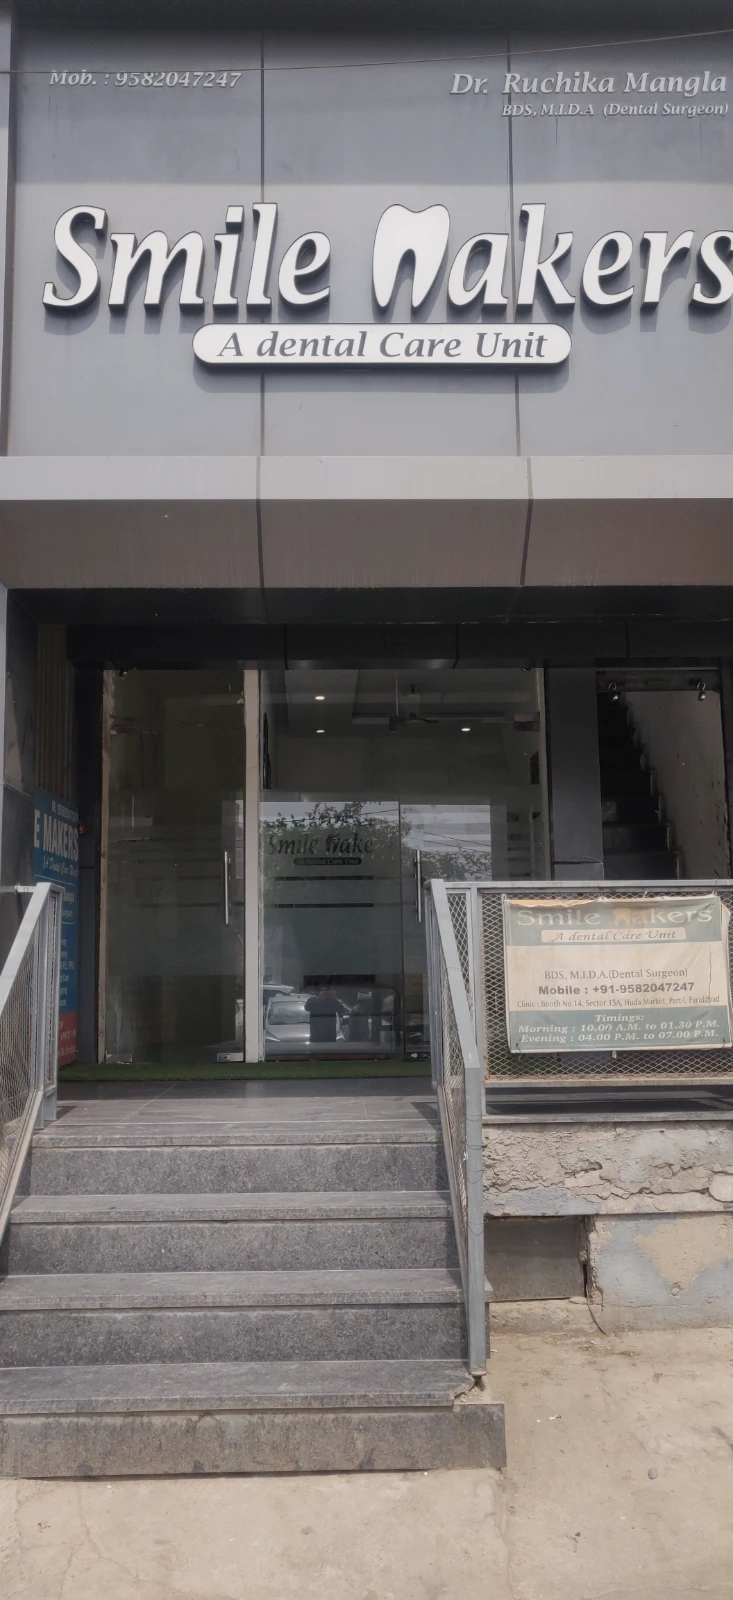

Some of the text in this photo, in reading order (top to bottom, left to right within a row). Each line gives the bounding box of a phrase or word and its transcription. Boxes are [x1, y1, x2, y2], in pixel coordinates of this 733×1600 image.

[49, 70, 97, 86] Mob.
[115, 71, 242, 88] 9582047247
[449, 71, 728, 98] Dr. Ruchika Mangla
[502, 103, 729, 118] BDS, M.I.D.A (Dental Surgeon)
[42, 203, 332, 311] Smile
[216, 331, 548, 358] A dental Care Unit
[43, 812, 79, 862] MAKERS
[516, 908, 600, 926] Smile
[552, 930, 676, 941] A dental Care Unit
[646, 968, 688, 979] Surgeon)
[538, 985, 580, 995] Mobile
[592, 982, 695, 995] +91-9582047247
[517, 1000, 535, 1008] Clinic
[585, 999, 607, 1007] Sector
[624, 998, 641, 1006] Huda
[688, 994, 720, 1003] Faridabad
[595, 1013, 645, 1023] Timings:
[518, 1024, 568, 1035] Morning
[580, 1023, 613, 1032] 10.00
[615, 1022, 641, 1031] A.M.
[645, 1021, 657, 1030] to
[660, 1020, 692, 1029] 01.30
[695, 1019, 720, 1029] P.M.
[521, 1034, 567, 1044] Evening
[578, 1032, 611, 1042] 04.00
[614, 1031, 640, 1041] P.M.
[643, 1030, 655, 1039] to
[658, 1029, 690, 1039] 07.00
[693, 1028, 719, 1038] P.M.
